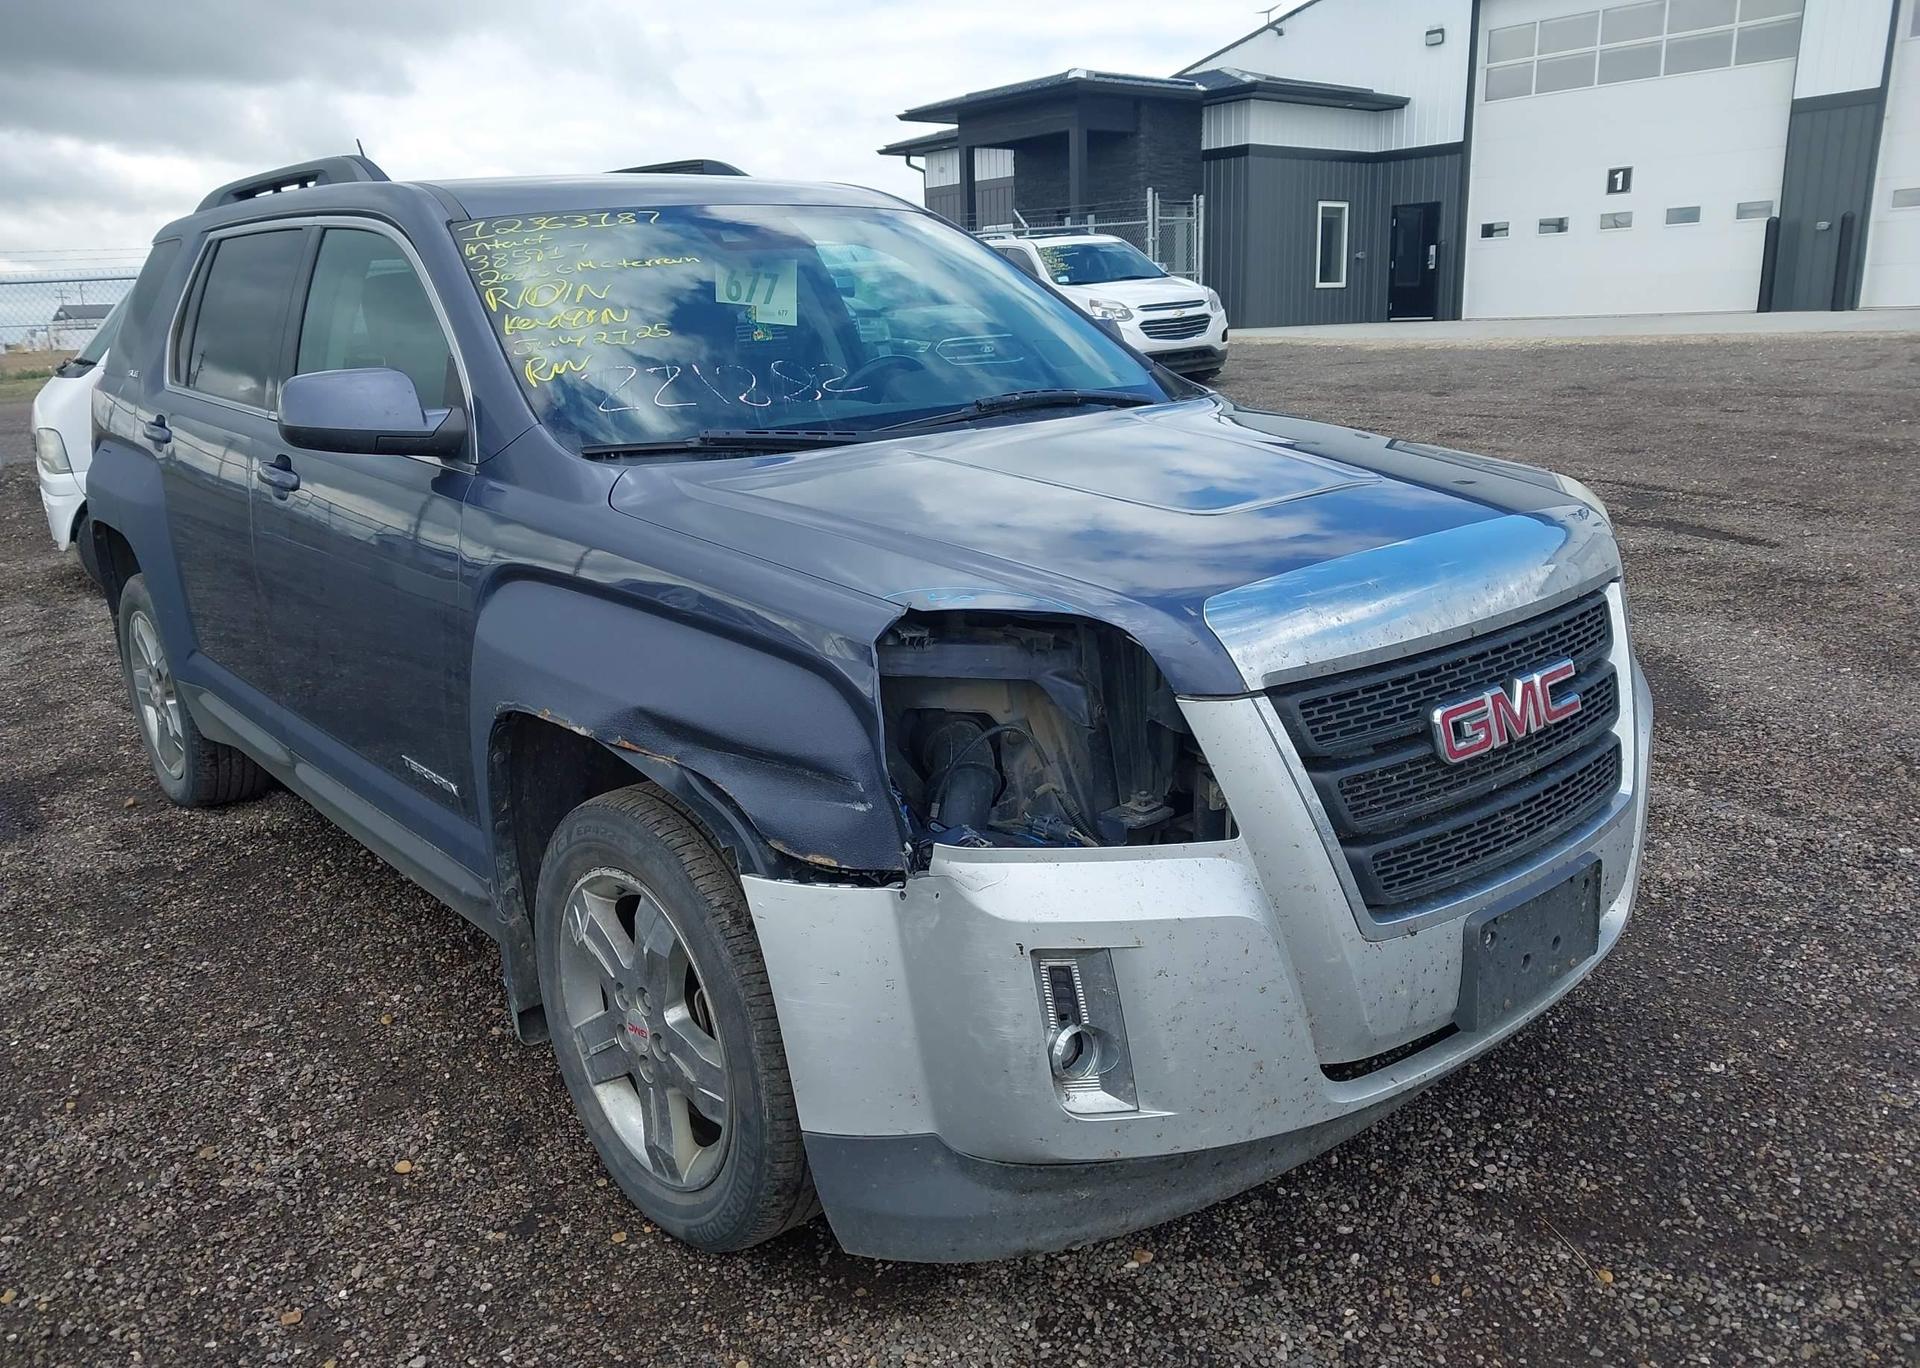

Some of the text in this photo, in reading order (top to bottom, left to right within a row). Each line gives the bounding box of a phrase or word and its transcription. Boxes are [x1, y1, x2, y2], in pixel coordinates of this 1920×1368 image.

[1613, 170, 1625, 191] 1
[725, 270, 780, 306] 677
[1432, 656, 1583, 764] GMC
[626, 1021, 649, 1040] GMC
